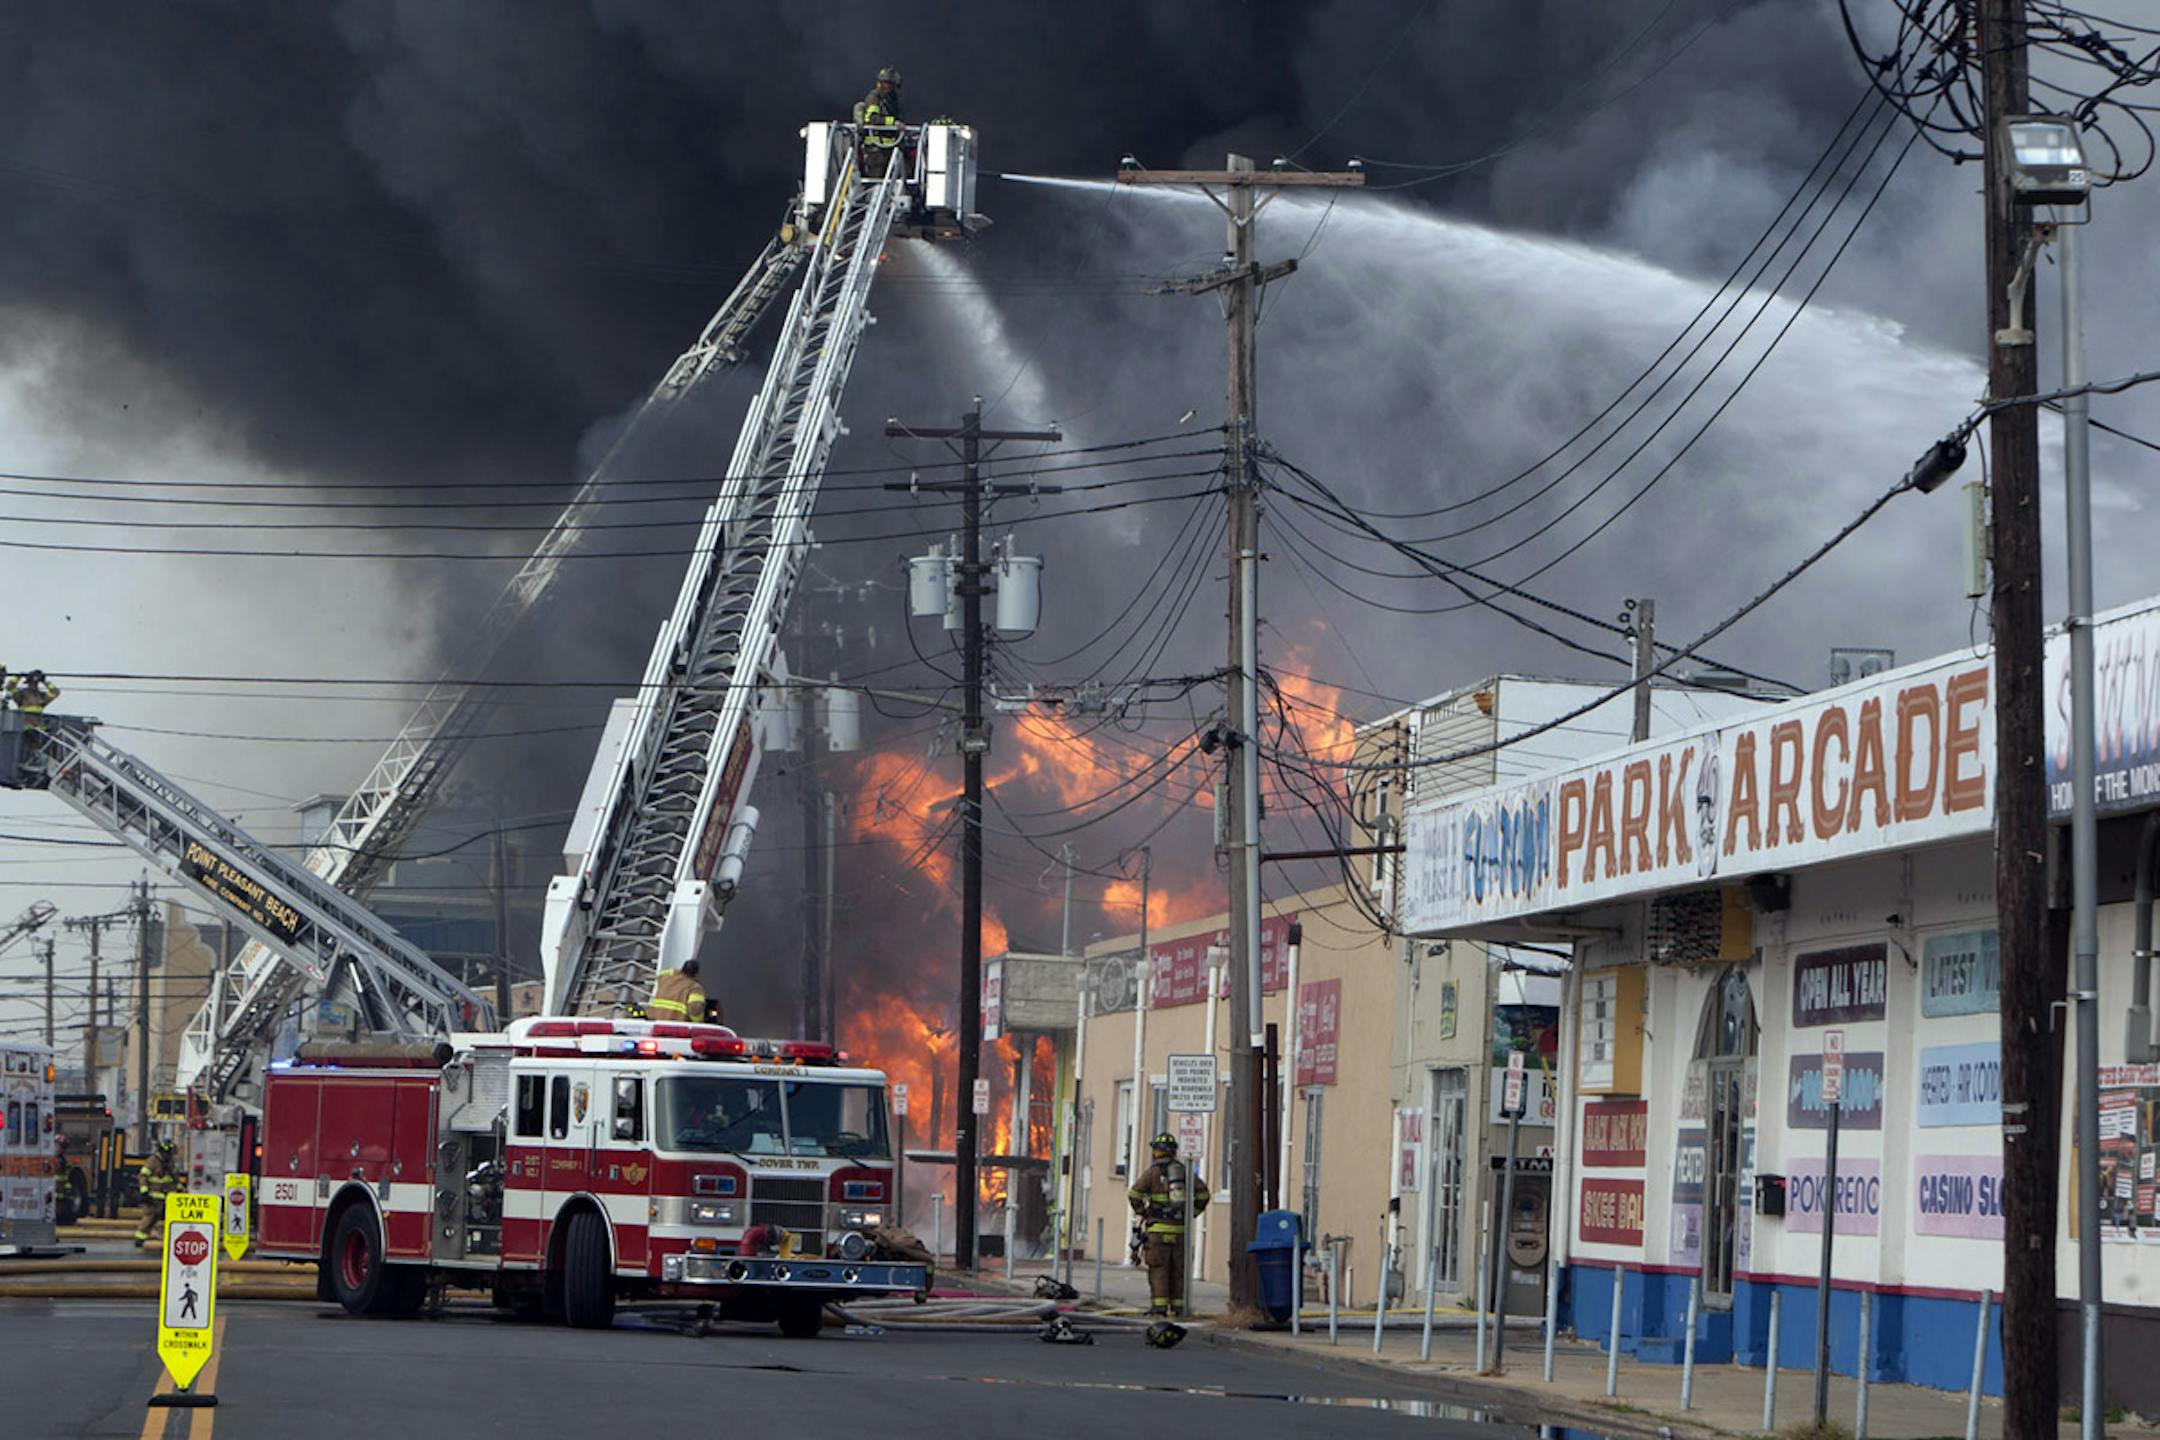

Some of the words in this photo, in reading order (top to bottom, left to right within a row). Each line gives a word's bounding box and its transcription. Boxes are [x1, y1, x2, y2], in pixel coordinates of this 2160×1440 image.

[1557, 746, 1694, 889] PARK
[1723, 667, 1988, 856] ARCADE
[2104, 770, 2128, 801] THE
[186, 841, 218, 870] POINT
[217, 861, 266, 902] PLEASANT
[265, 896, 298, 932] BEACH
[1801, 966, 1829, 1011] OPEN
[1830, 963, 1850, 1008] ALL
[1852, 960, 1885, 1005] YEAR
[1931, 952, 1976, 997] LATEST
[759, 1159, 793, 1169] DOVER
[176, 1197, 210, 1207] STATE
[275, 1184, 298, 1200] 2501
[1919, 1174, 1974, 1215] CASINO
[181, 1210, 204, 1219] LAW
[1583, 1190, 1616, 1229] SKEE
[175, 1240, 208, 1256] STOP
[163, 1340, 207, 1349] CROSSWALK
